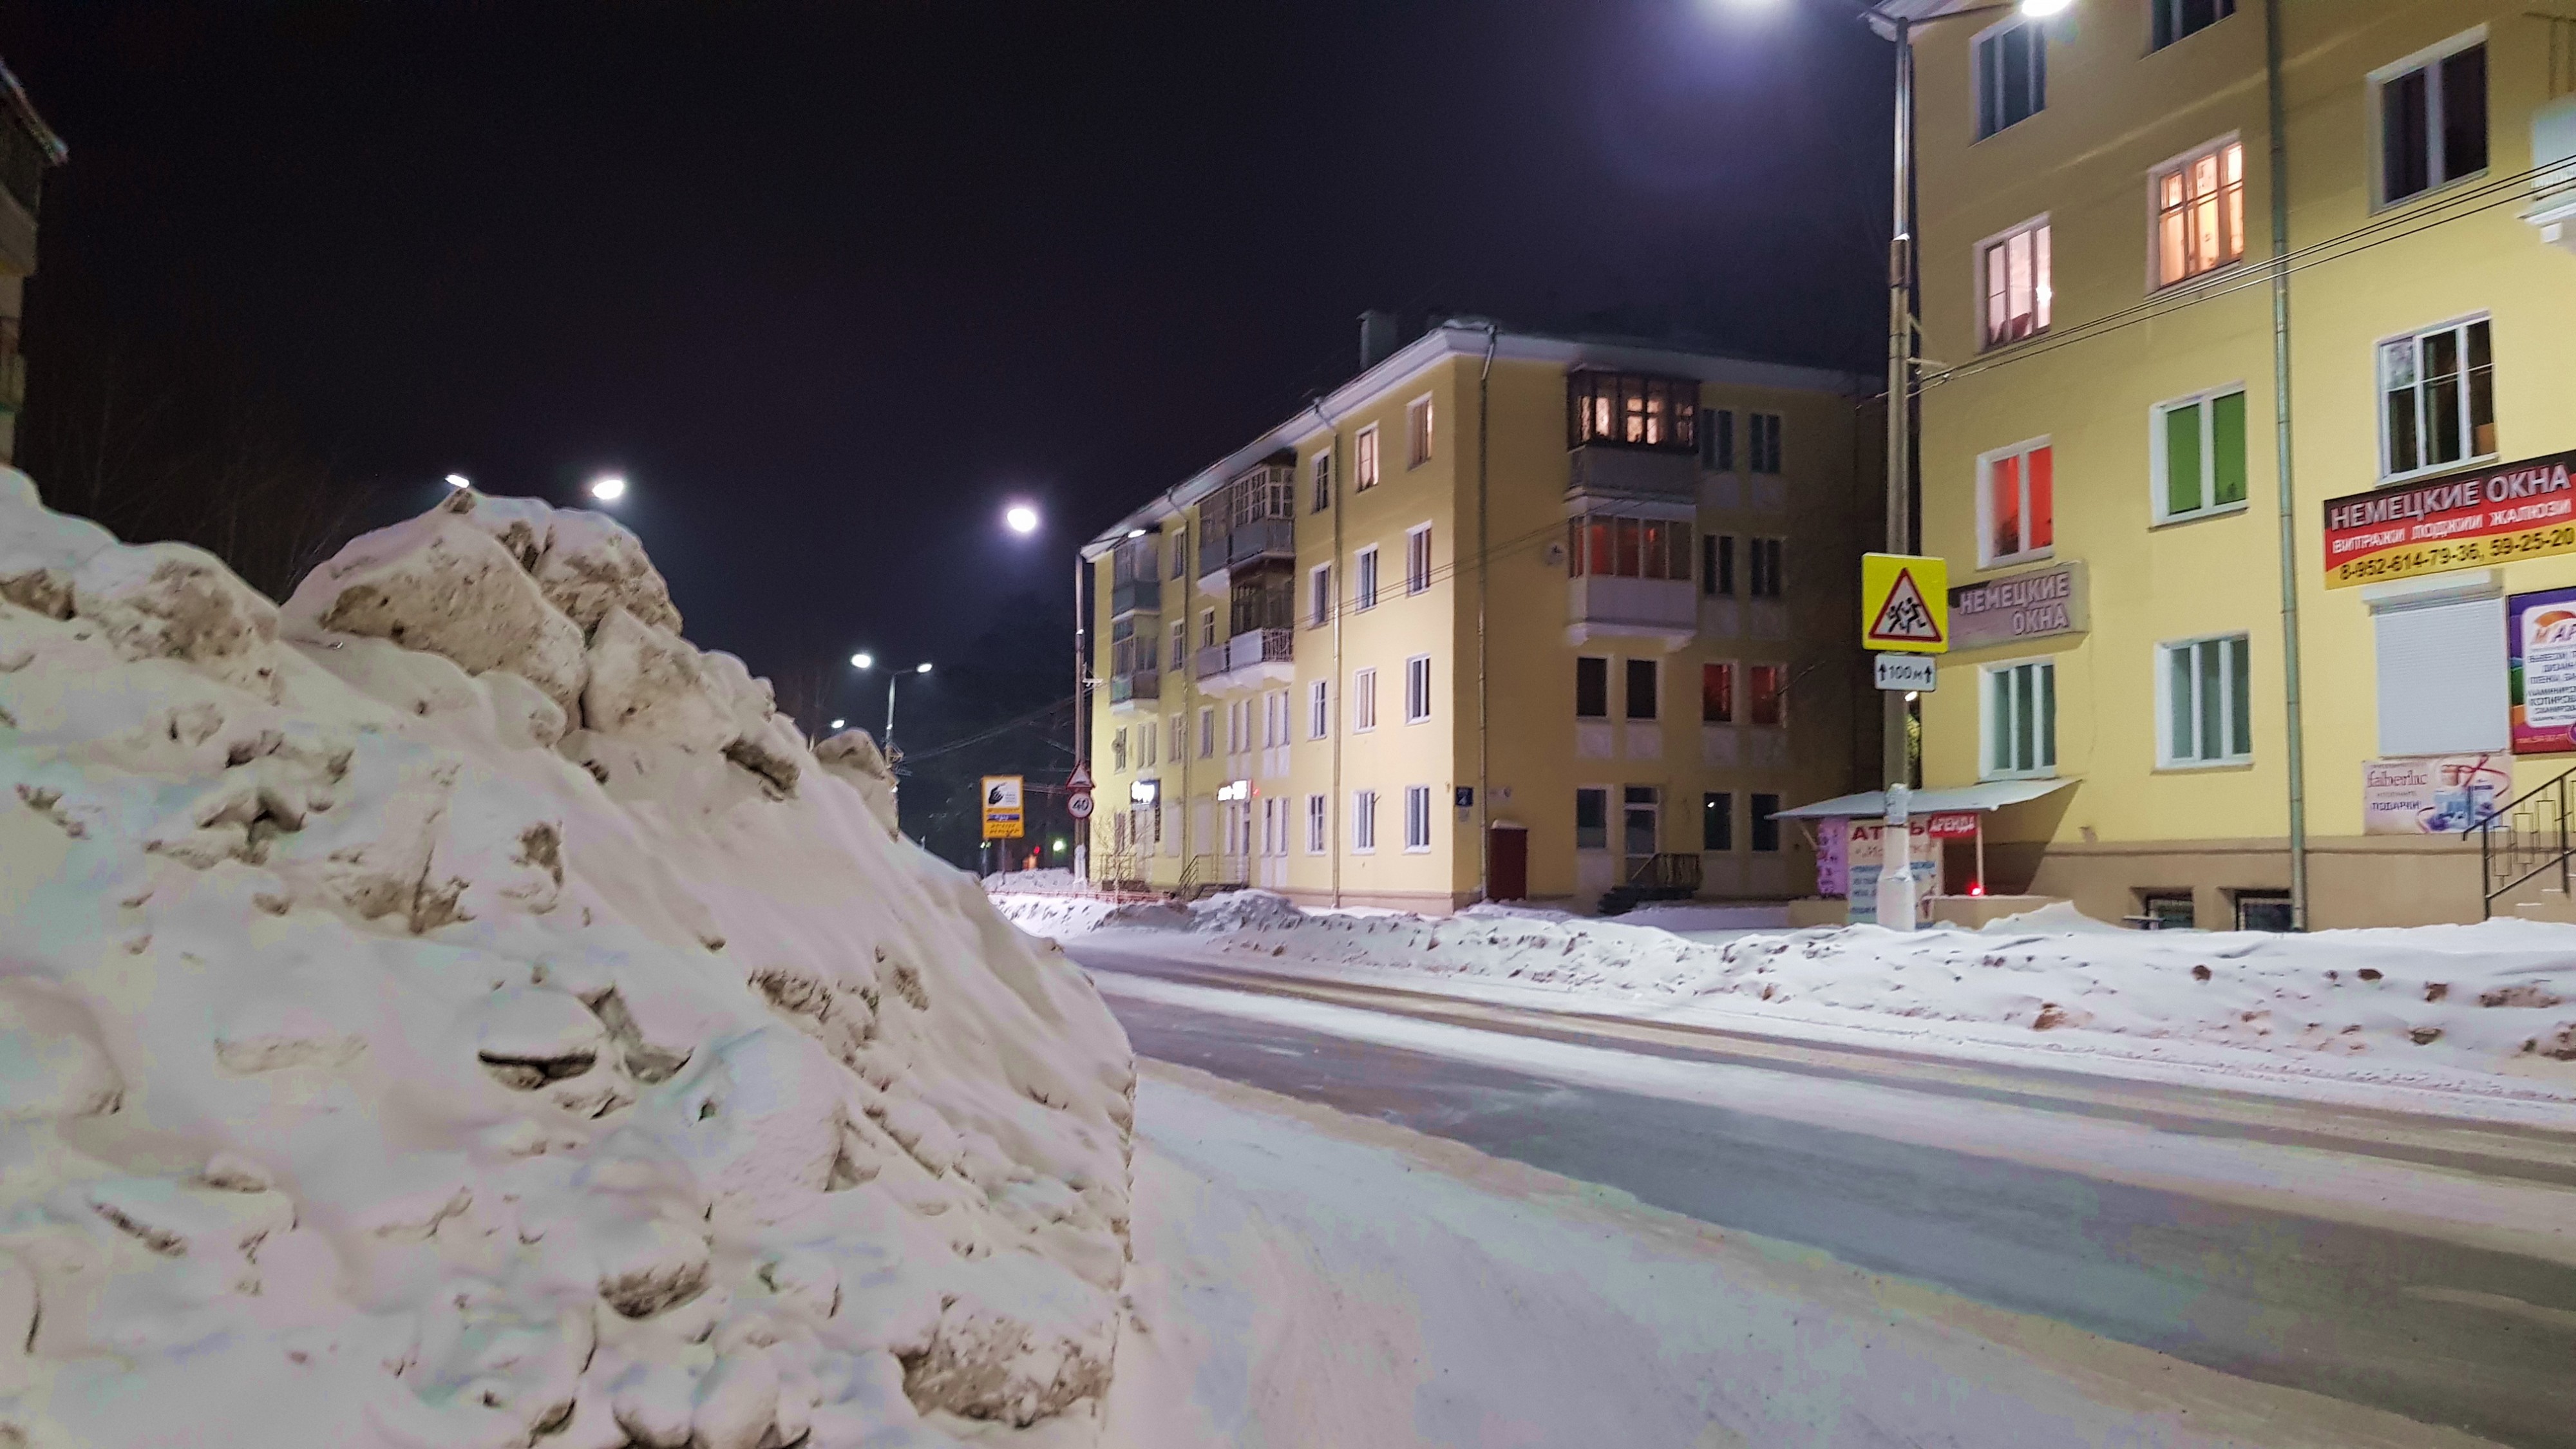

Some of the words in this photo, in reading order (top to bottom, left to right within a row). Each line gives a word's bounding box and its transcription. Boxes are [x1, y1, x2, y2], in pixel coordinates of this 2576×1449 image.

[2331, 480, 2480, 531] НЕМЕЦКИЕ
[2486, 463, 2571, 503] ОКНА
[2333, 527, 2405, 553] ВИТРАЖИ
[2488, 498, 2571, 527] ЖАЛЮЗИ
[2490, 527, 2575, 556] 59-25-20
[1959, 573, 2070, 614] НЕМЕЦКИЕ
[2012, 603, 2069, 636] ОКНА
[1072, 798, 1089, 811] 40
